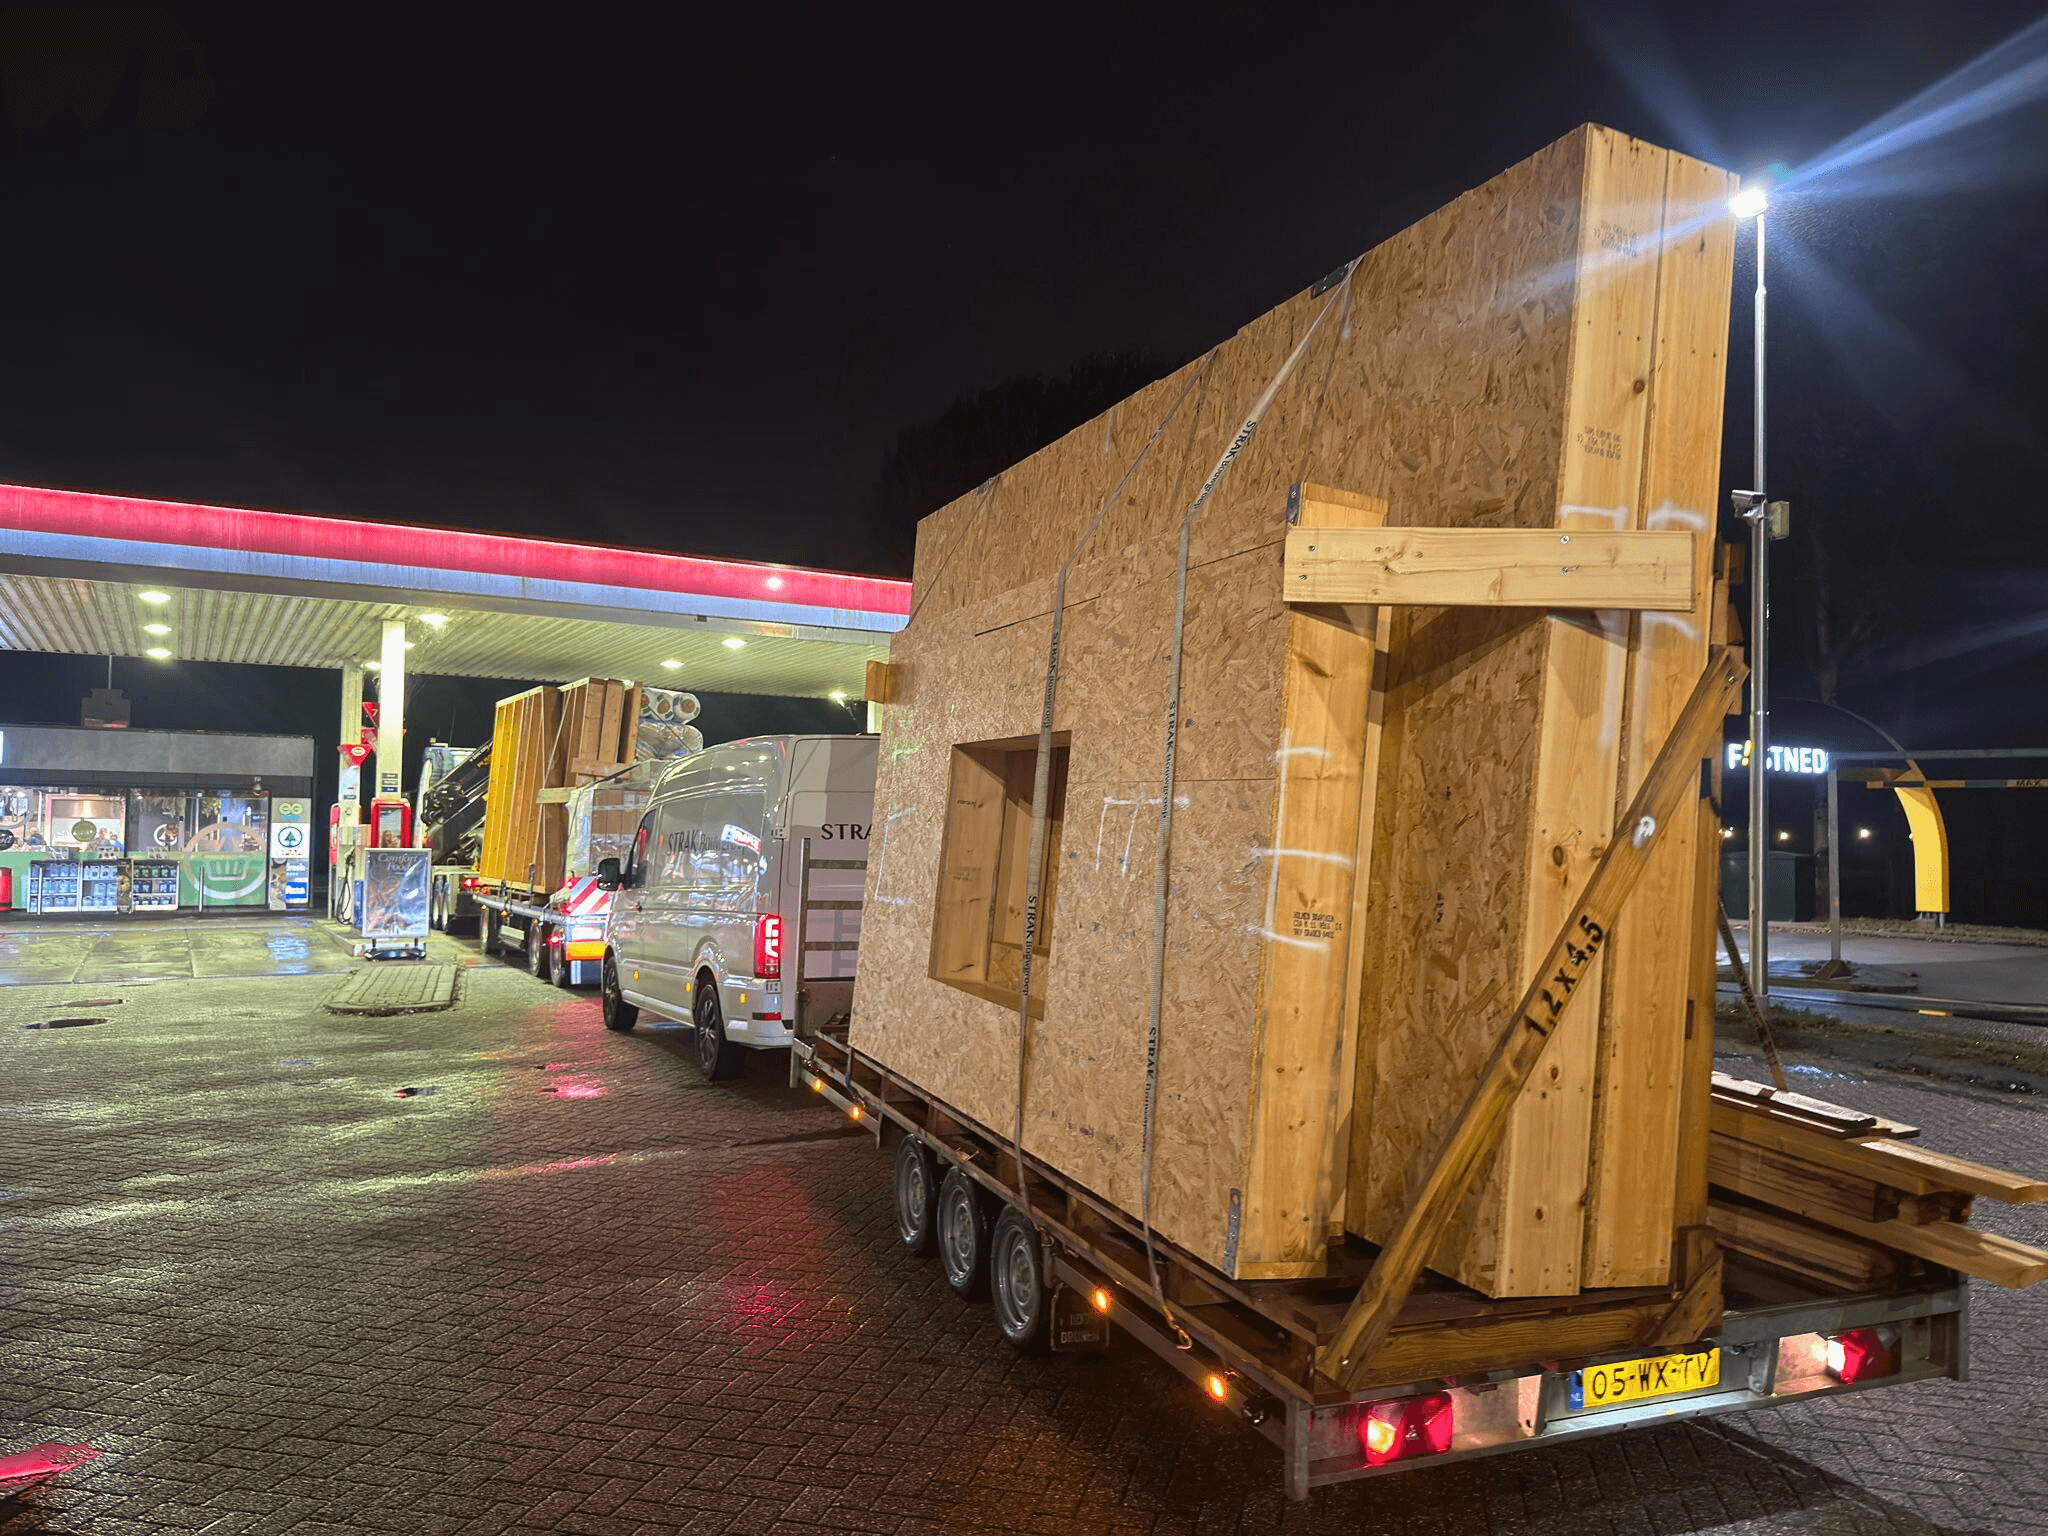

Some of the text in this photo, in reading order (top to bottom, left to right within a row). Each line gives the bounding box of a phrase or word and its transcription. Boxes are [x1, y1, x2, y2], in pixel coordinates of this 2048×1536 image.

[1225, 421, 1257, 459] STRAK
[1049, 632, 1059, 674] STRAK
[1166, 701, 1177, 752] STRAK
[1728, 740, 1829, 774] FTNED
[669, 829, 699, 855] STRAK
[1026, 895, 1038, 938] STRAK
[1524, 987, 1563, 1037] 1,2
[1566, 915, 1603, 967] 4,5
[1147, 1026, 1156, 1079] STRAK
